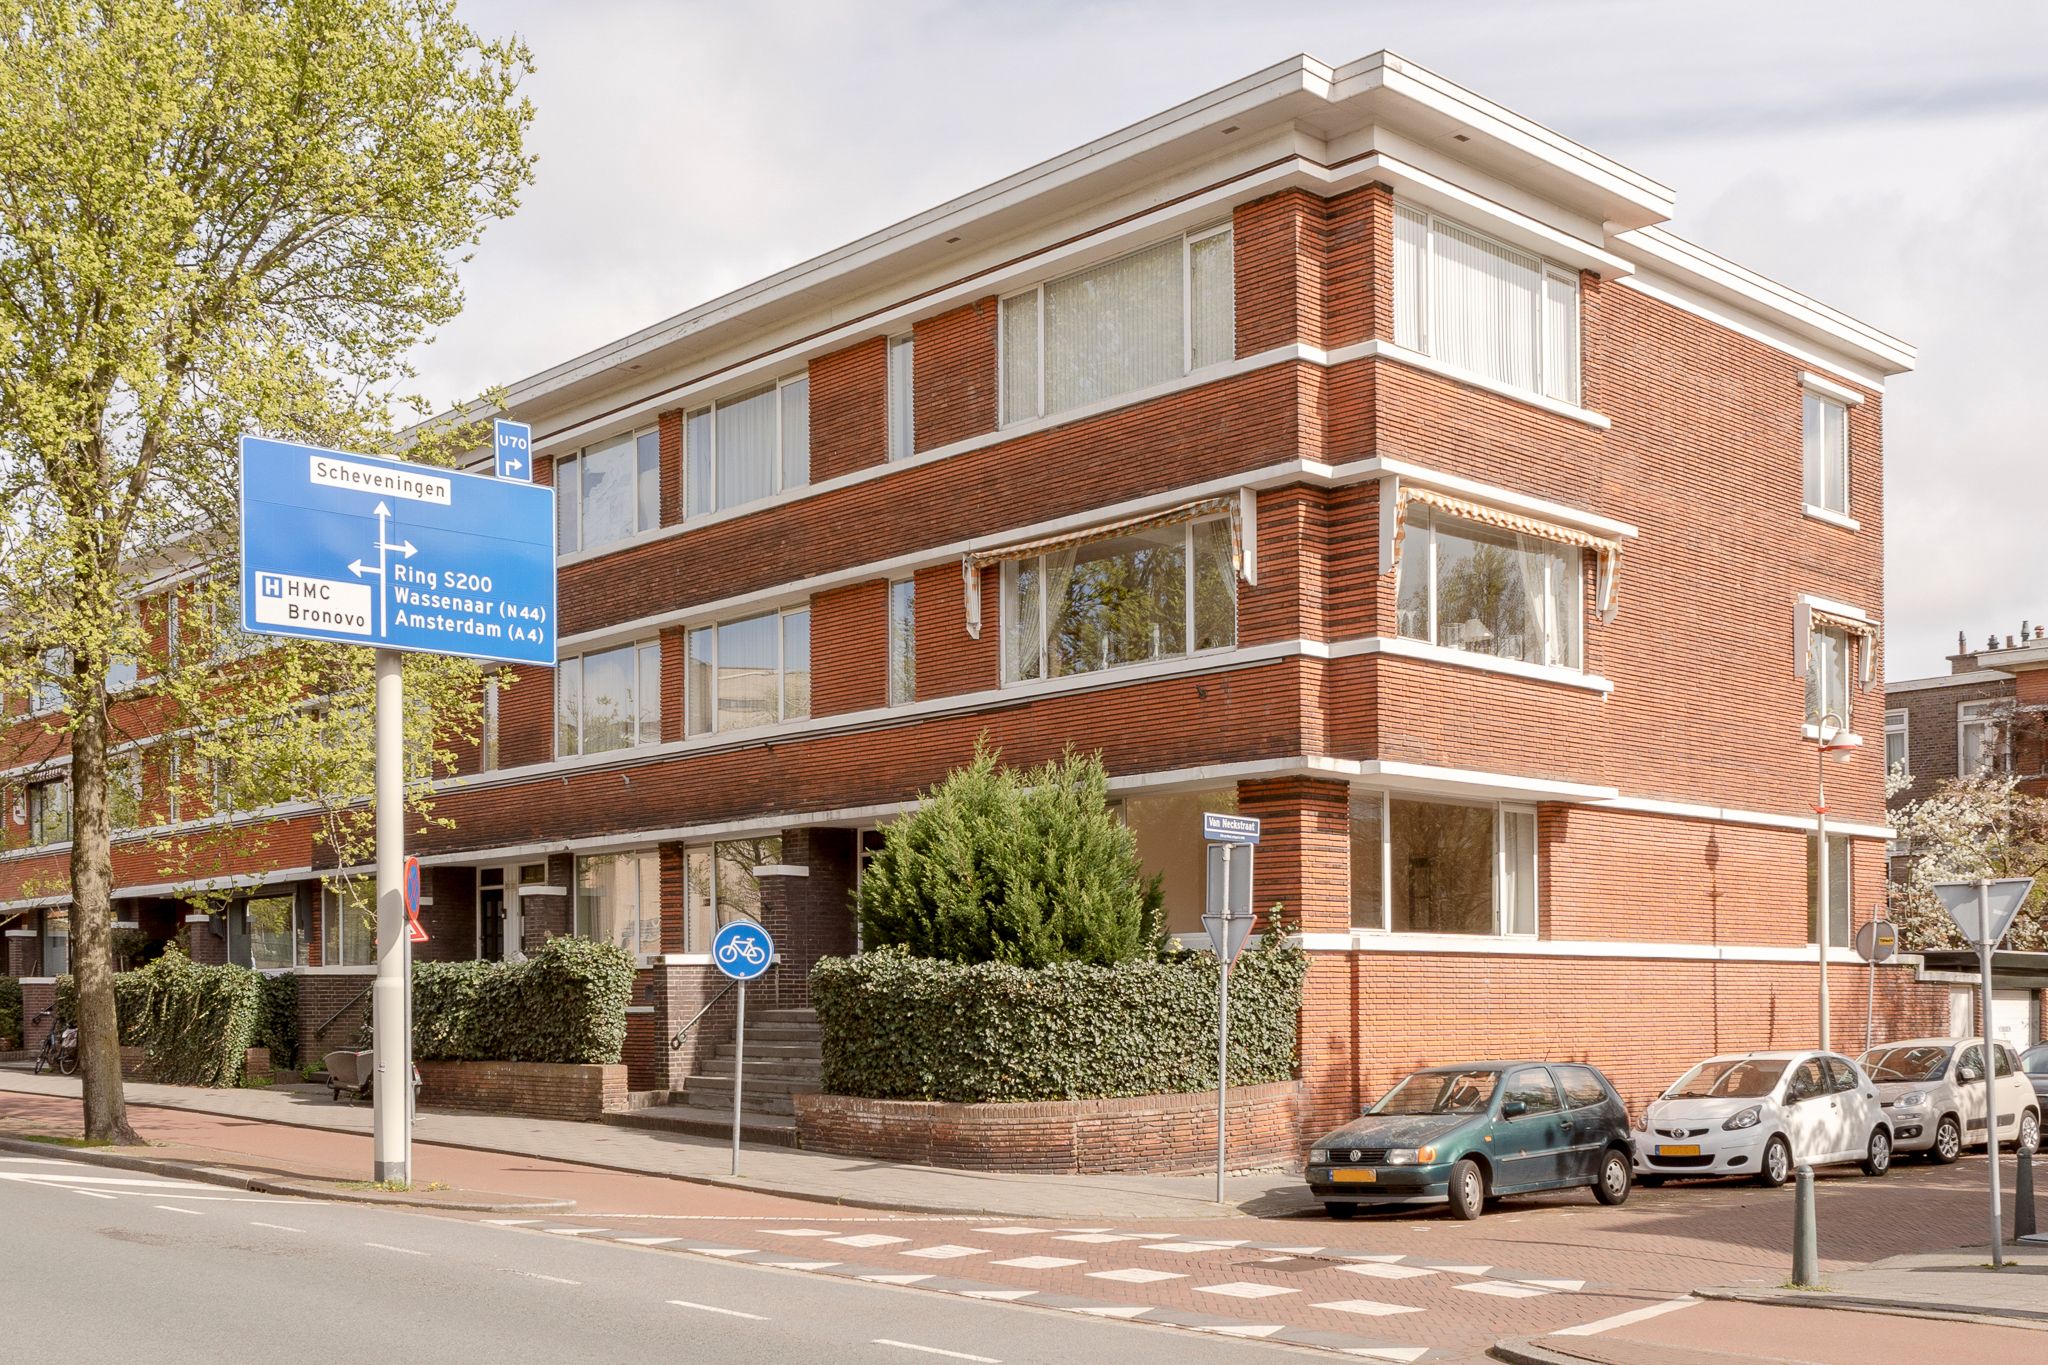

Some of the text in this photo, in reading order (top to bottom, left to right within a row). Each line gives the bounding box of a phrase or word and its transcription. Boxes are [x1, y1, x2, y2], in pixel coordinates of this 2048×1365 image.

[499, 434, 527, 450] U70
[317, 462, 445, 498] Scheveningen
[288, 580, 330, 600] HMC
[394, 563, 493, 593] Ring S200
[288, 603, 365, 628] Bronovo
[394, 586, 547, 624] Wassenaar (N44)
[395, 609, 545, 645] Amsterdam (A4)
[1208, 816, 1255, 831] Van Neckstraat
